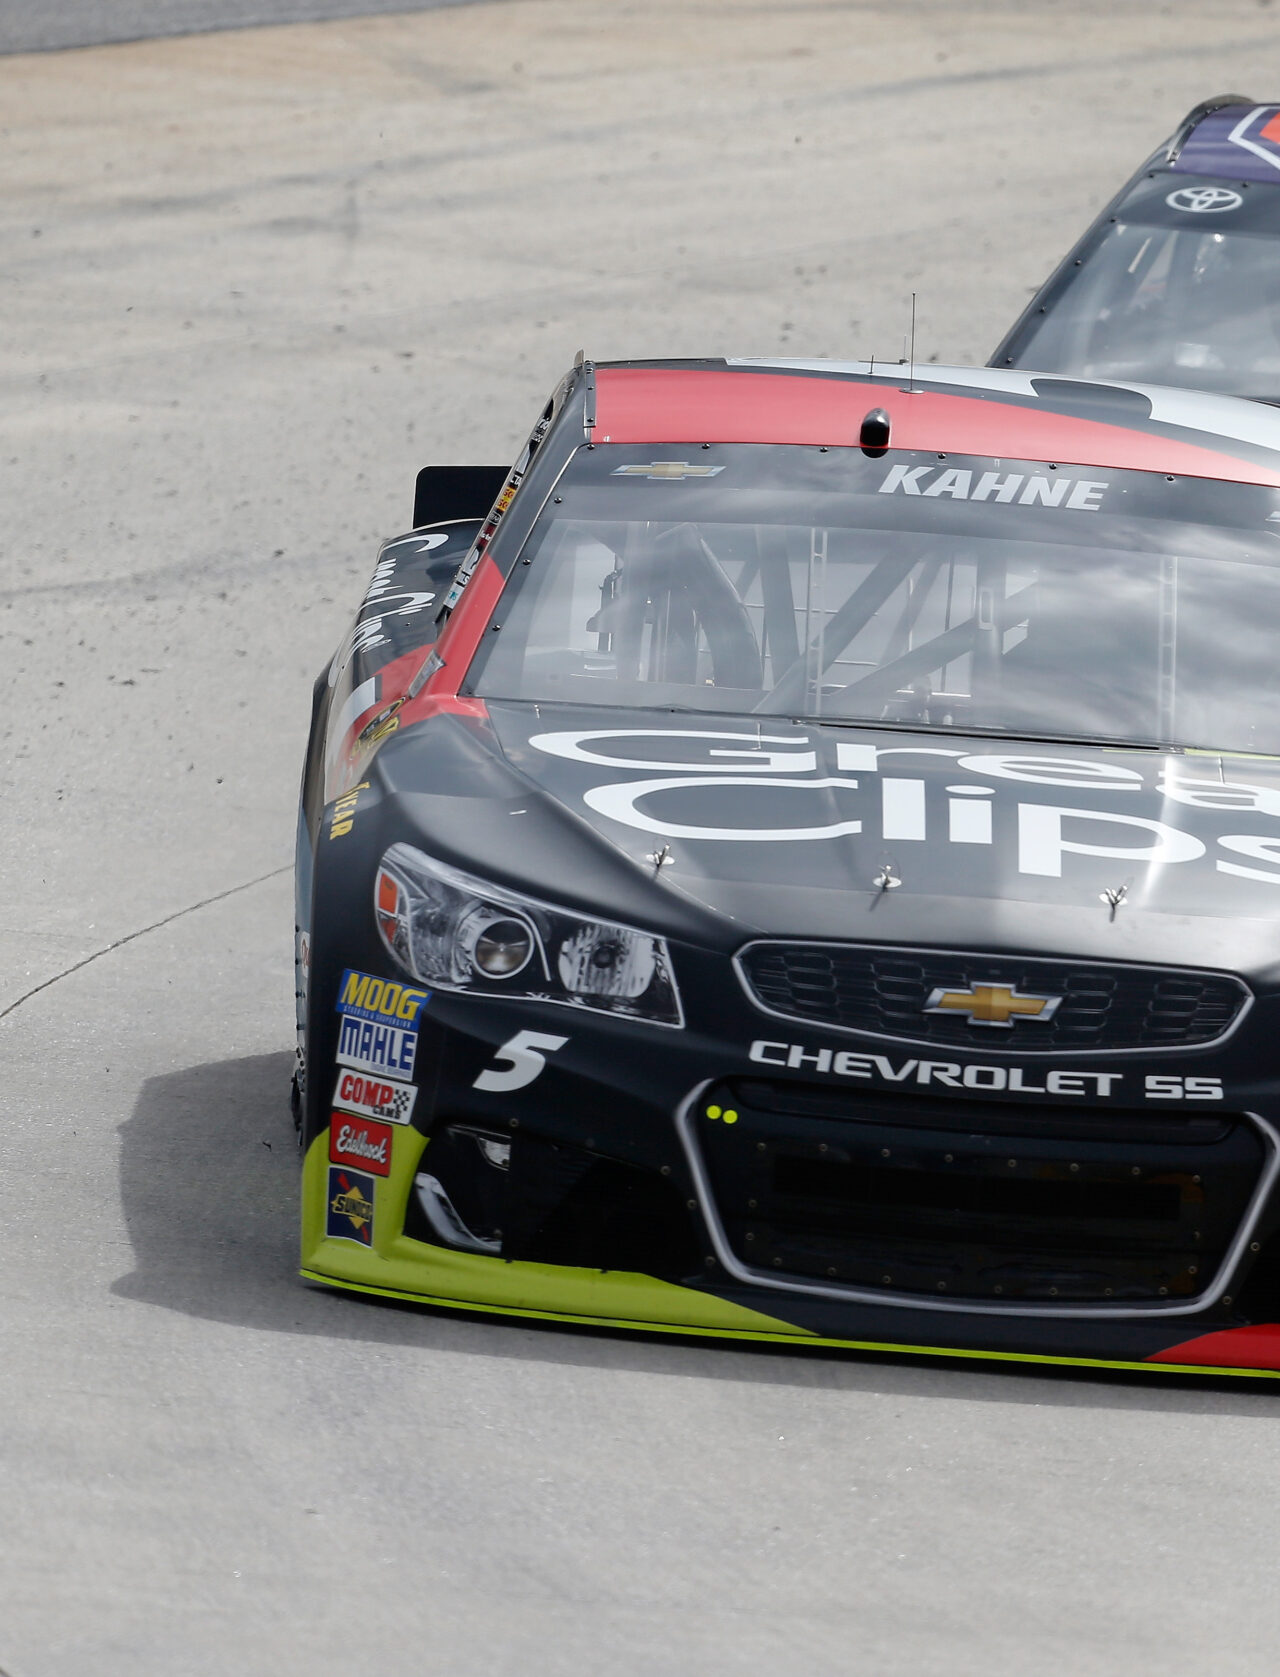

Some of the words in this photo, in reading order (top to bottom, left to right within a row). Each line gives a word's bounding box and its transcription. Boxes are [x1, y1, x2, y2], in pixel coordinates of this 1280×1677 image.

[879, 464, 1109, 511] KAHNE
[340, 972, 428, 1020] MOOG
[339, 1017, 415, 1071] MAHLE
[472, 1030, 570, 1092] 5
[340, 1074, 394, 1107] COMP
[749, 1039, 1123, 1096] CHEVROLET
[1145, 1075, 1223, 1100] SS
[372, 1104, 402, 1120] CAMS
[336, 1124, 388, 1164] Edelbrock
